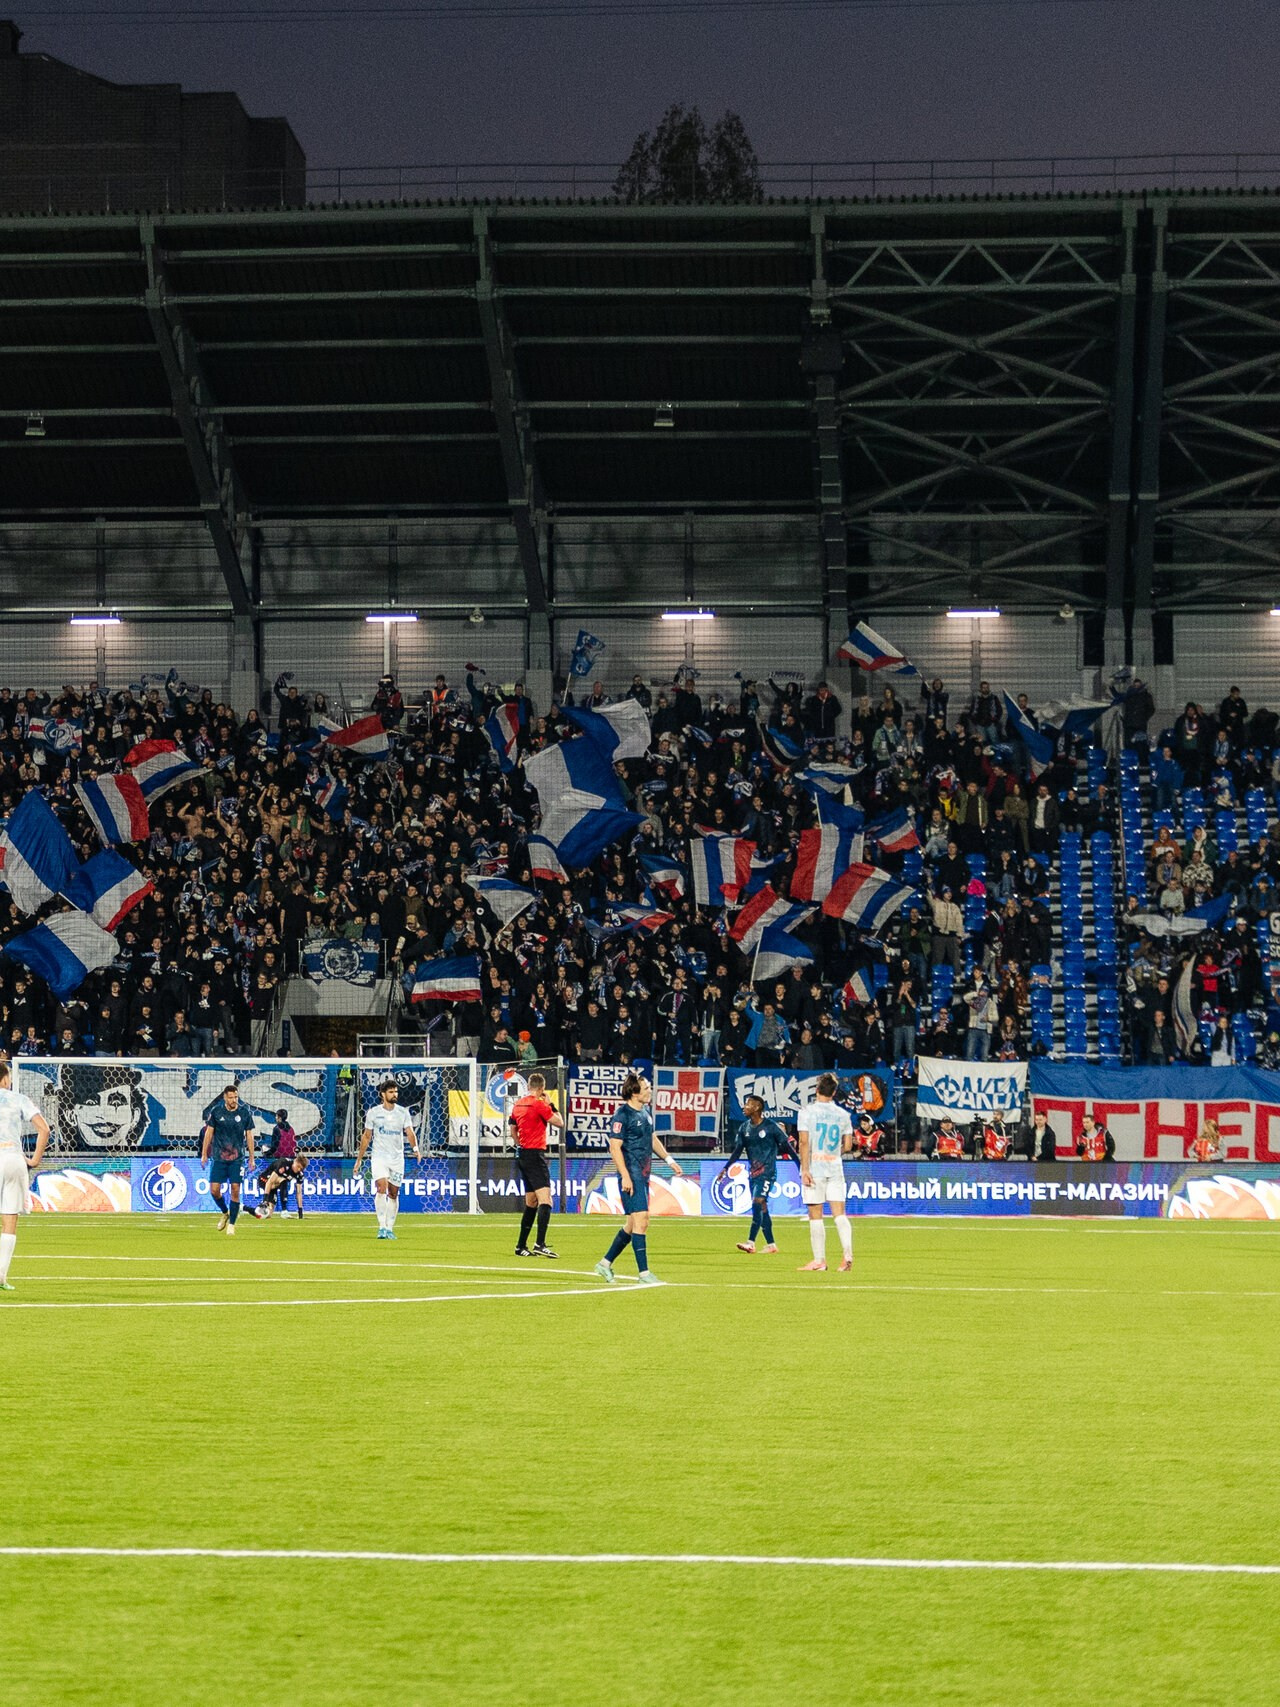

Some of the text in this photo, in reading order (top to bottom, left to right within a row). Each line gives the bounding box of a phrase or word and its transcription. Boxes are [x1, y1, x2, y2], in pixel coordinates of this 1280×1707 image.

[575, 1082, 624, 1096] FORC
[734, 1073, 818, 1112] FAKE
[934, 1074, 1022, 1110] ФАКЕЛ
[816, 1122, 840, 1152] 79
[768, 1178, 1169, 1201] ОФАЛЬНЫЙ ИНТЕРНЕТ-МАГАЗИН
